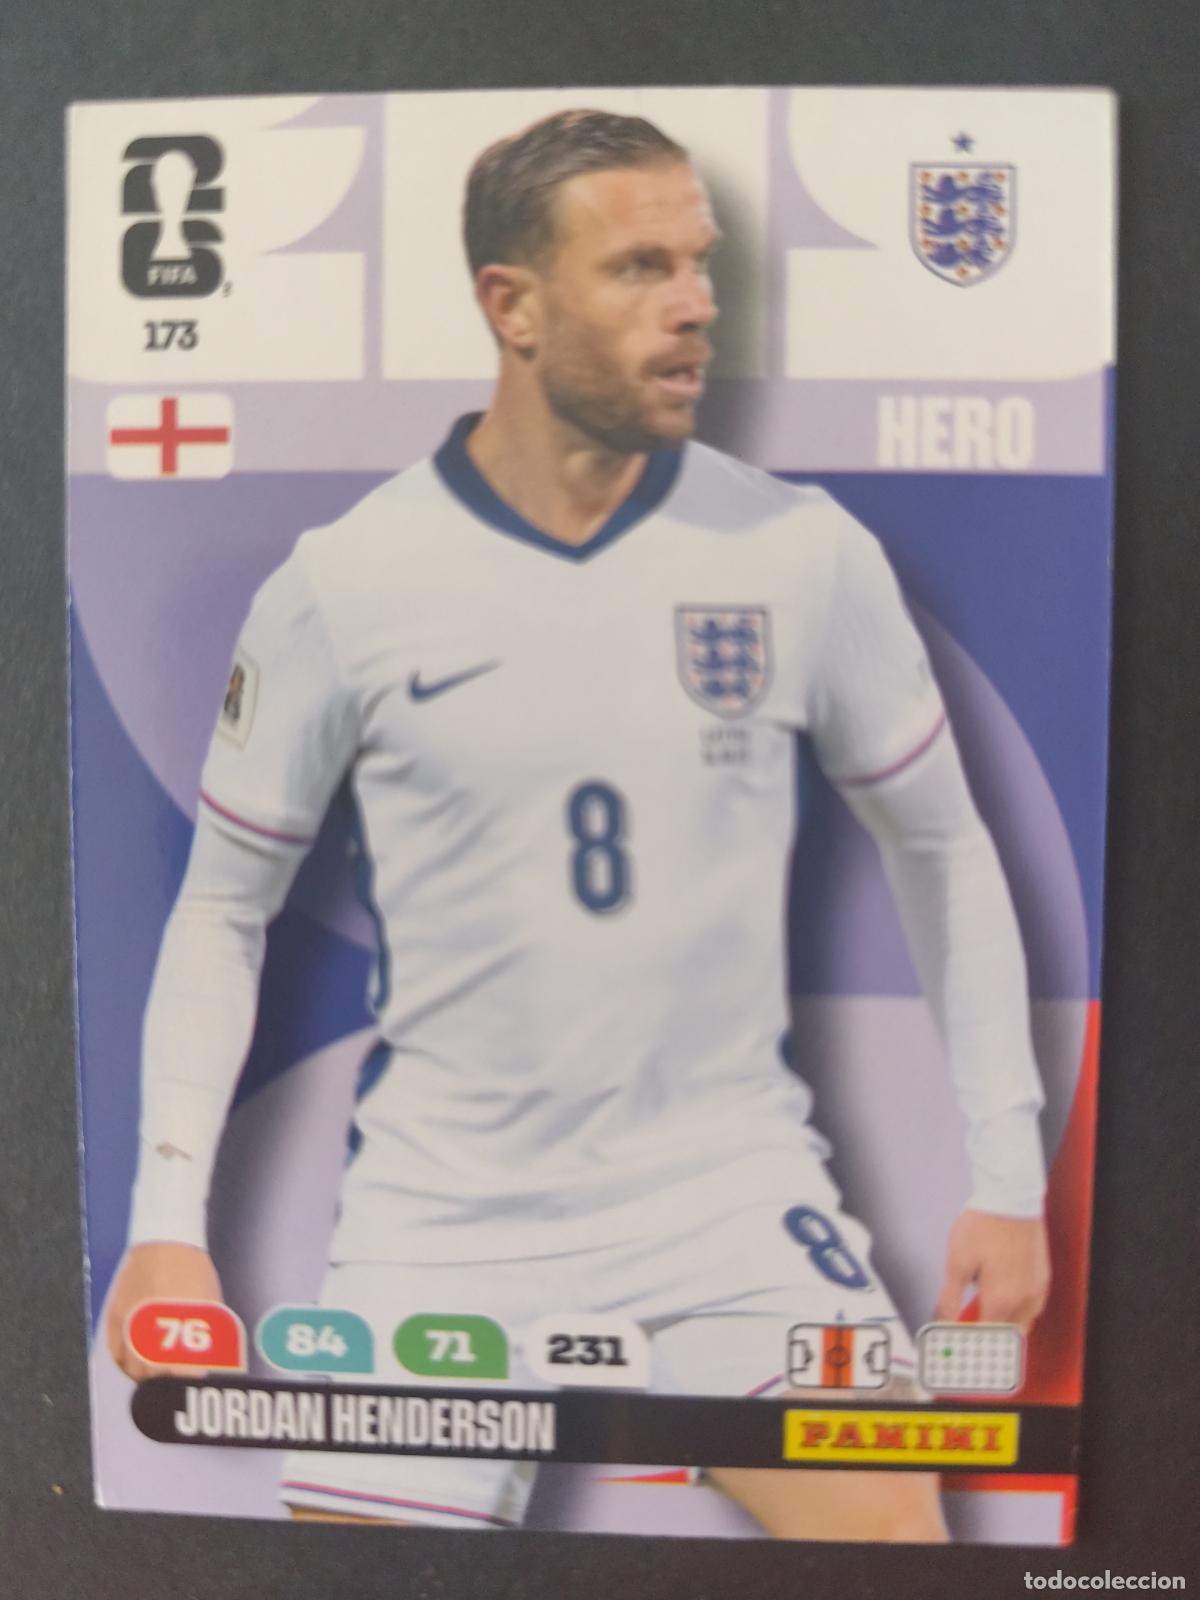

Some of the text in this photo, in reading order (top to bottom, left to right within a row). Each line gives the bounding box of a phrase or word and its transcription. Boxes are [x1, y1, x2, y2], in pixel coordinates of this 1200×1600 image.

[147, 264, 197, 285] FIFA
[144, 320, 198, 351] 173
[878, 397, 1035, 469] HERO
[567, 780, 632, 915] 8
[784, 1205, 870, 1288] 8
[156, 1317, 212, 1351] 76
[286, 1323, 348, 1357] 84
[425, 1329, 476, 1362] 71
[547, 1334, 628, 1366] 231
[174, 1386, 556, 1451] JORDAN HENDERSON
[800, 1421, 1001, 1451] PANINI
